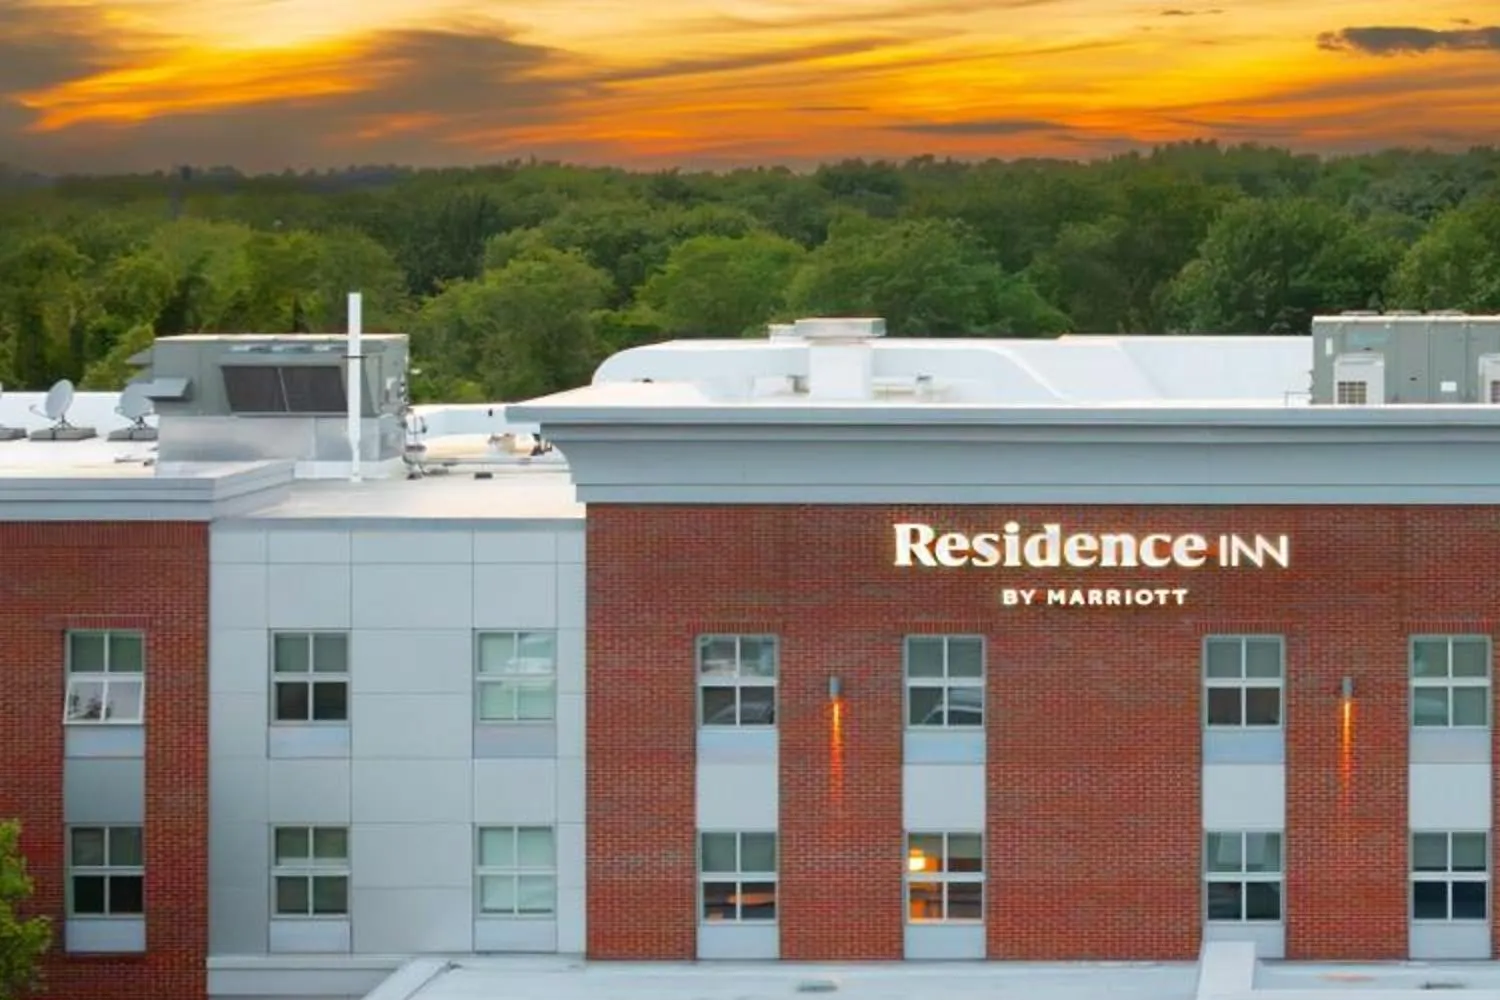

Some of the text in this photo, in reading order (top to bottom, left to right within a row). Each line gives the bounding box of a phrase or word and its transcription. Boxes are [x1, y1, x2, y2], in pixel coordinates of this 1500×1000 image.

[893, 522, 1289, 568] Residence INN
[1002, 589, 1188, 605] BY MARRIOTT
